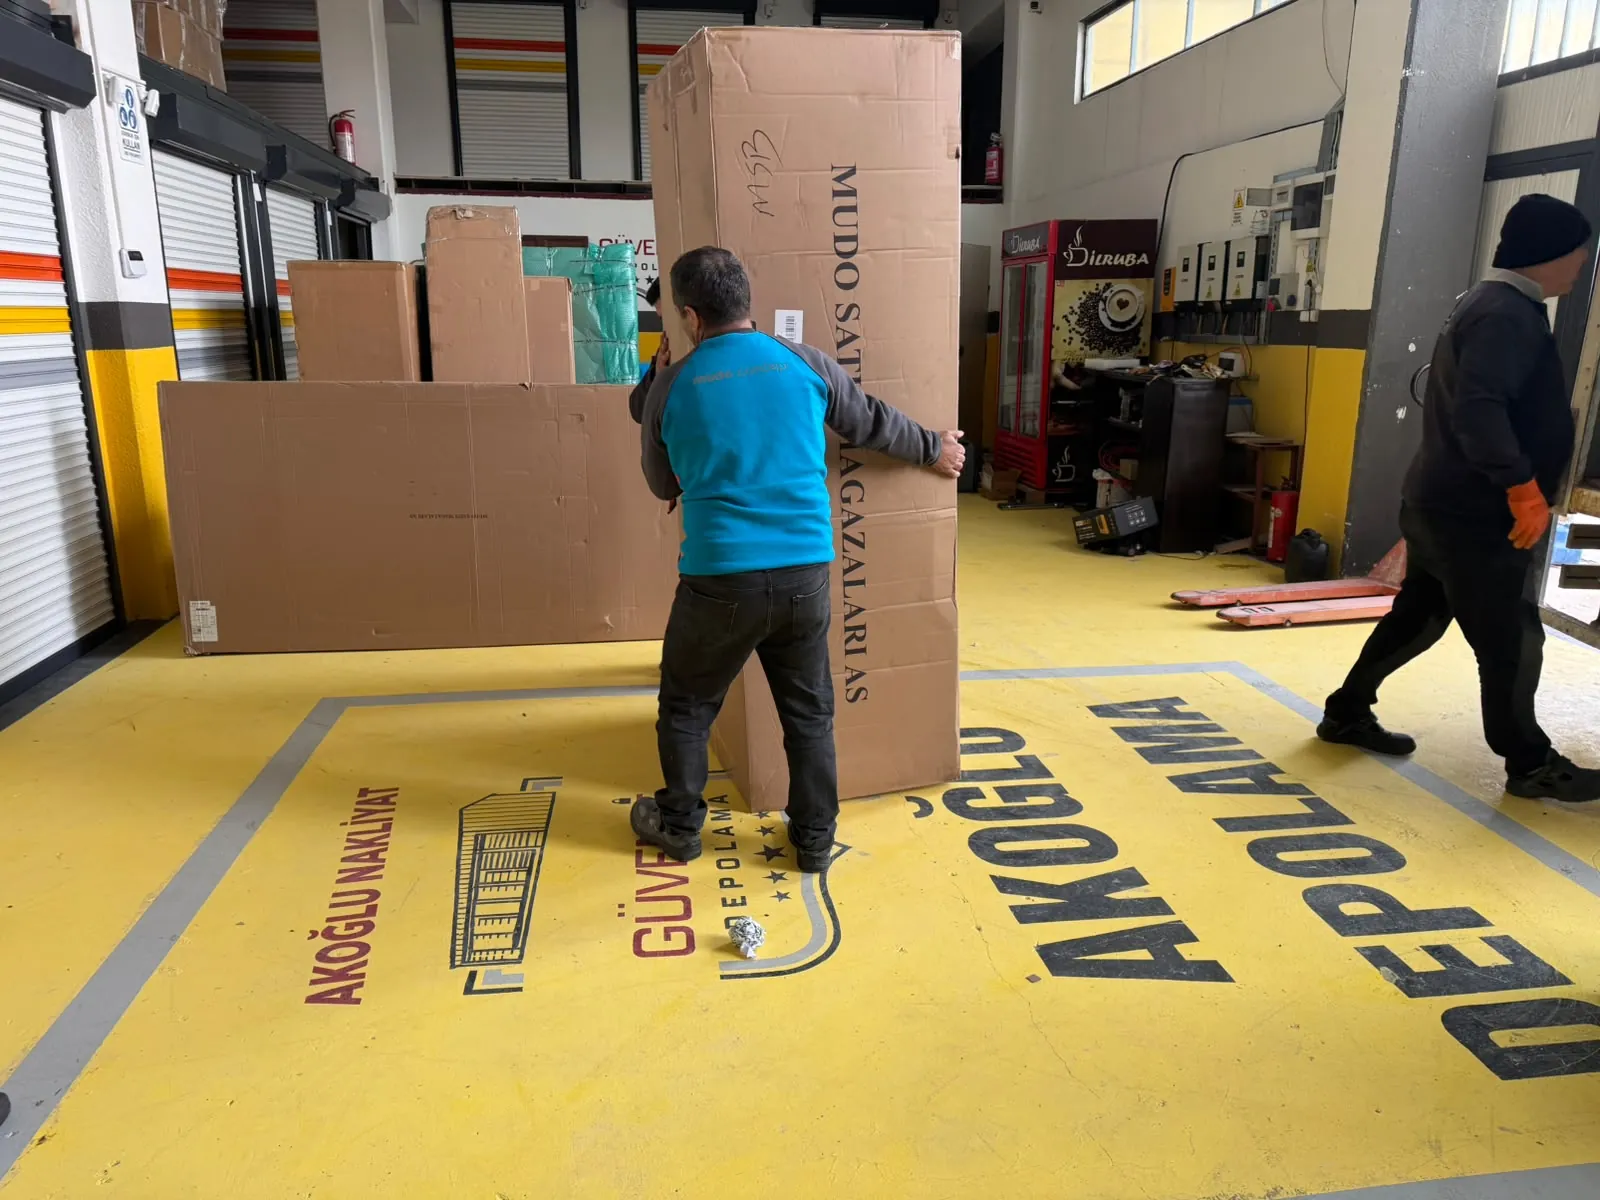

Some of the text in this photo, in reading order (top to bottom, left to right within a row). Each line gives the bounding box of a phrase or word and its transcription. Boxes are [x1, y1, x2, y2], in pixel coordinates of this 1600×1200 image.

[831, 162, 860, 291] MUDO
[834, 302, 862, 386] SAT
[304, 787, 400, 1005] AKOĞLU NAKLİYAT
[617, 793, 697, 958] GÜVE
[905, 727, 1236, 983] AKOĞLU
[1086, 696, 1600, 1081] DEPOLAMA
